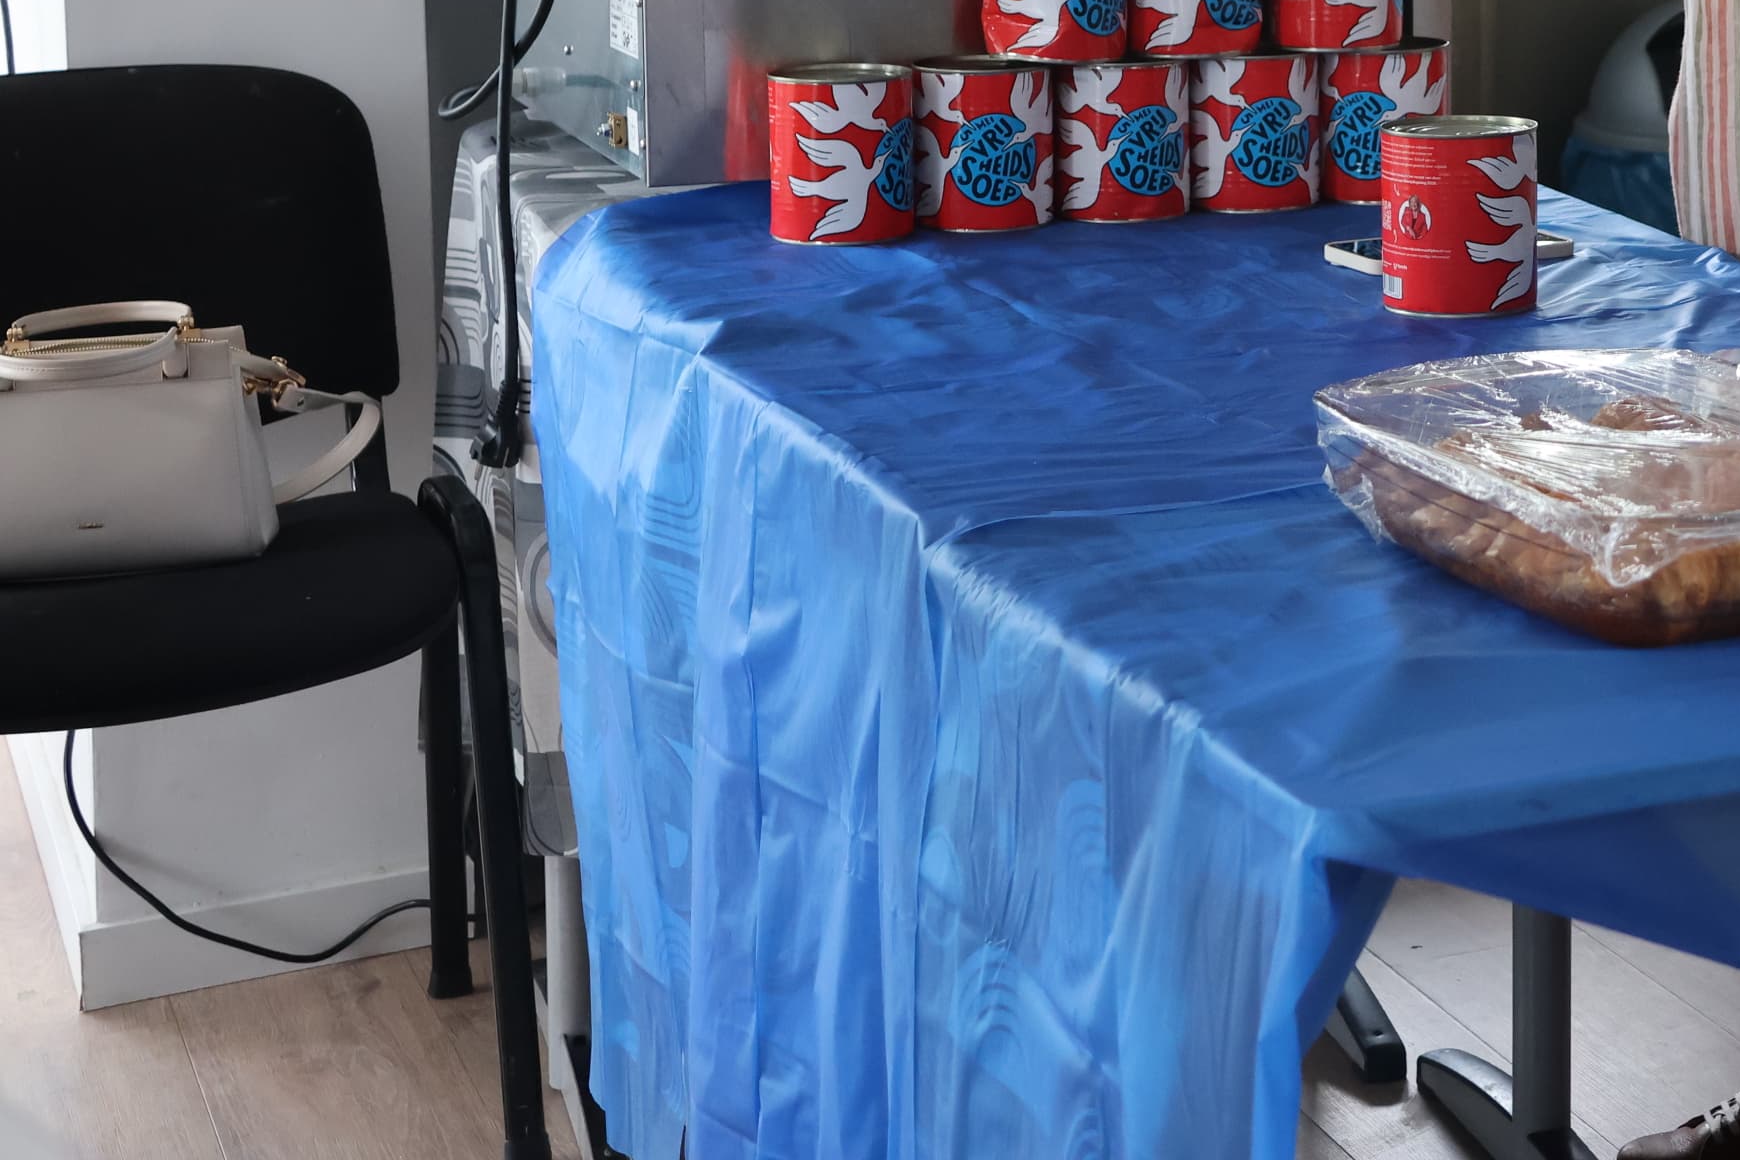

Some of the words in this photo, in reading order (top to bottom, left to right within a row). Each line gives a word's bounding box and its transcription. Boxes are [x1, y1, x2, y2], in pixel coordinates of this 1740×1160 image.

[1118, 122, 1131, 134] 5
[1127, 109, 1167, 149] VRIJ
[1240, 112, 1254, 125] 5
[1251, 101, 1292, 140] VRIJ
[1342, 95, 1383, 133] VRIJ
[960, 130, 973, 141] 5
[970, 118, 1013, 158] VRIJ
[1137, 132, 1182, 169] HEIDS
[1259, 125, 1309, 162] HEIDS
[1350, 128, 1382, 154] HEI
[957, 156, 1017, 201] SOEP
[978, 142, 1033, 179] HEIDS
[1115, 148, 1171, 191] SOEP
[1238, 139, 1294, 183] SOEP
